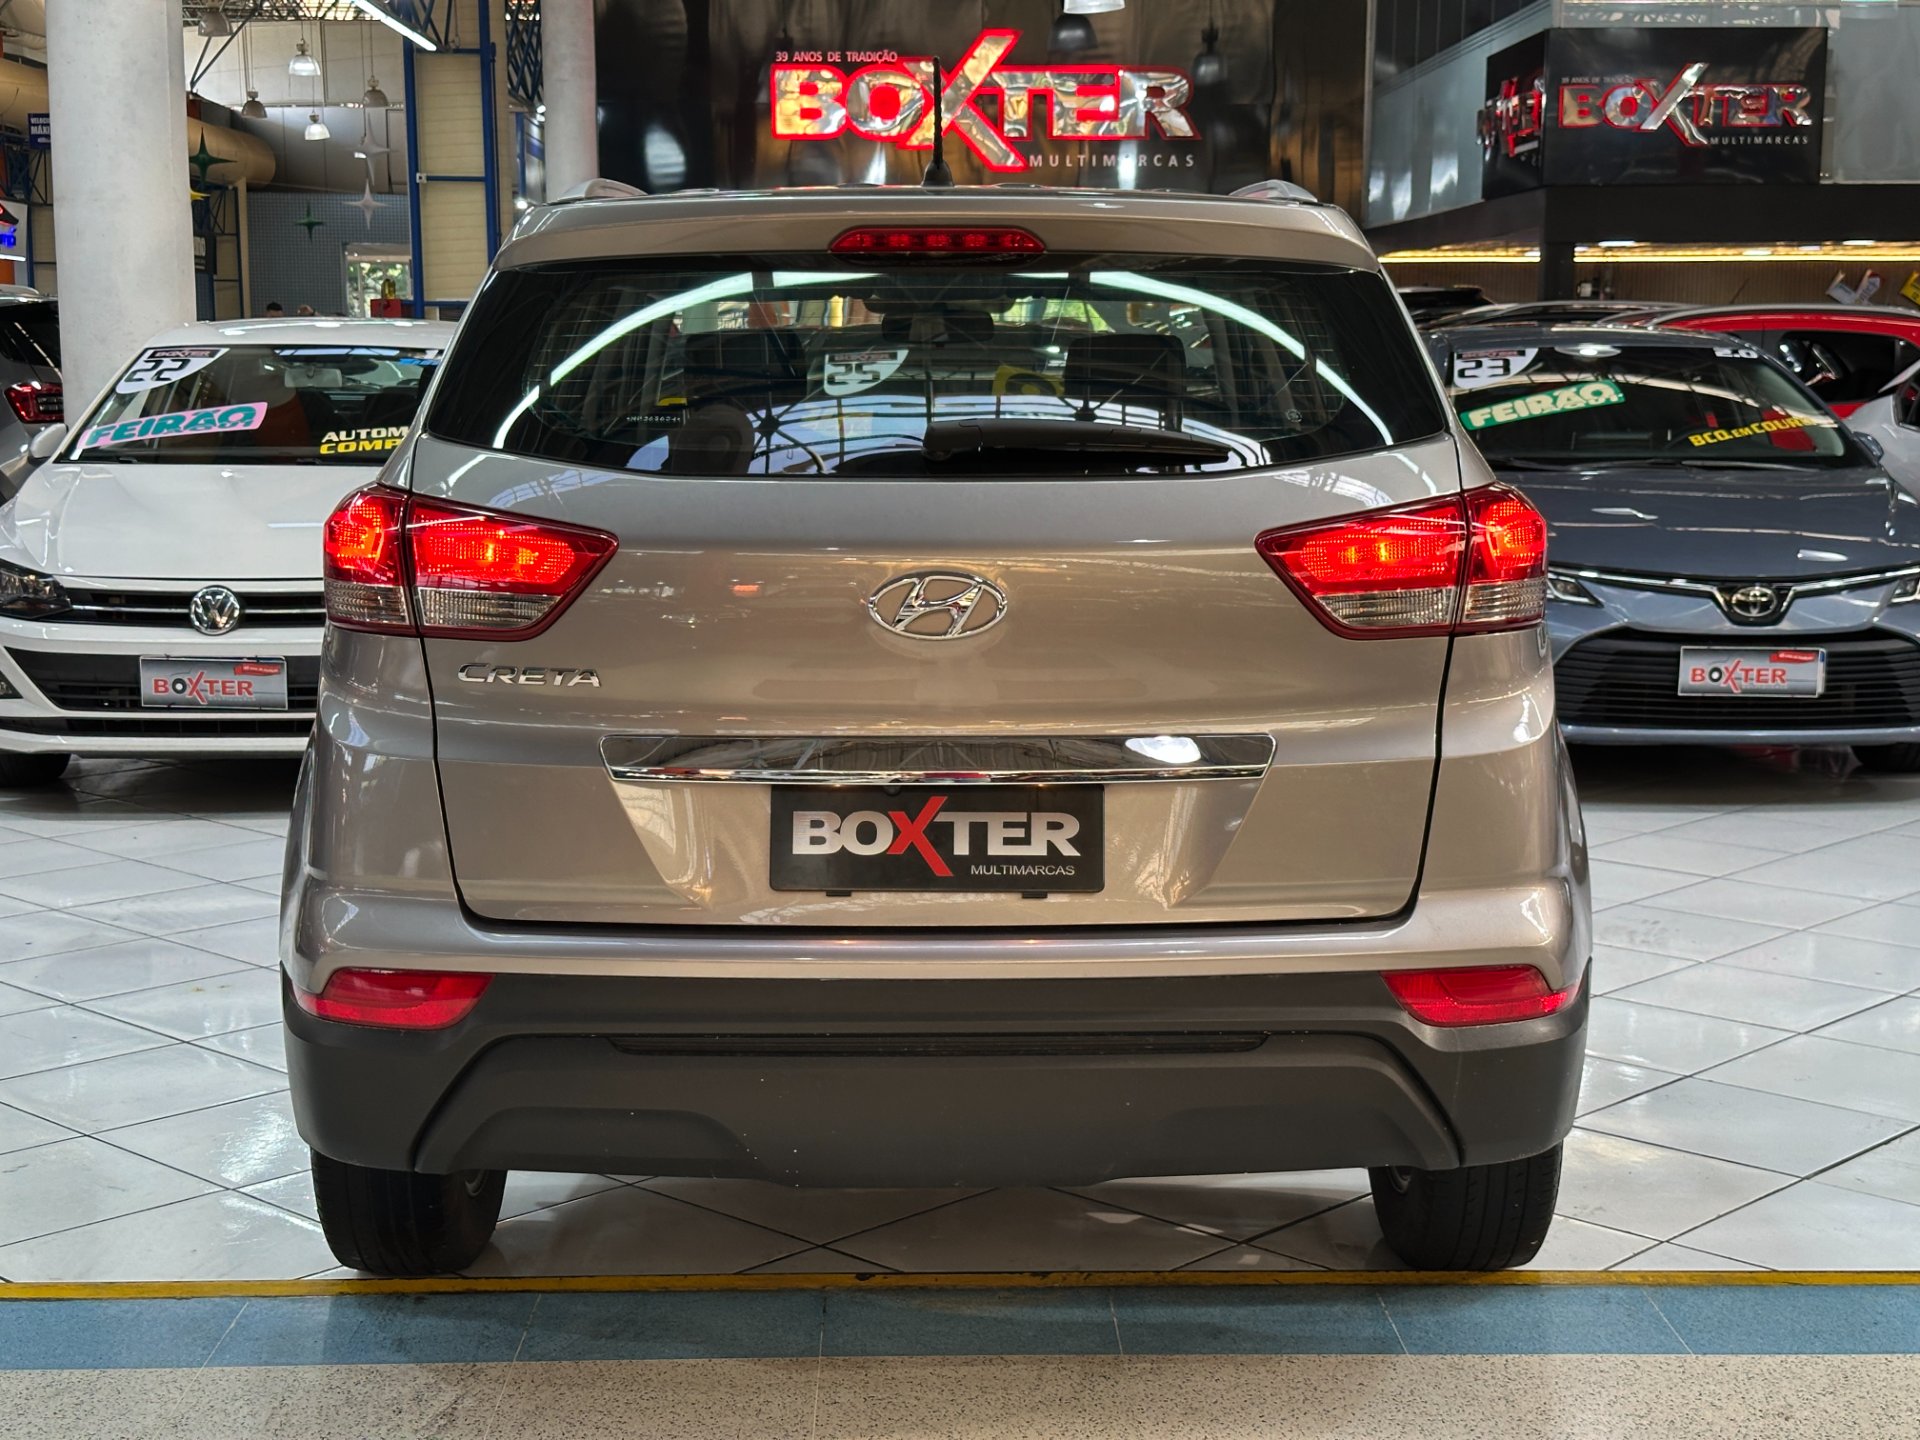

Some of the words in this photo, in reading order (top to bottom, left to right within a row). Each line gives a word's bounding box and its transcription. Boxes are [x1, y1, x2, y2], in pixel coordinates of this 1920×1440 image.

[775, 51, 788, 62] 39
[793, 51, 822, 62] ANOS
[827, 51, 841, 62] DE
[846, 49, 898, 64] TRADIÇÃO
[770, 28, 1201, 172] BOXTER
[1557, 62, 1813, 147] BOXTER
[1710, 136, 1809, 145] MULTIMARCAS
[1029, 154, 1195, 168] MULTIMRCAS
[124, 358, 191, 382] 22
[1457, 358, 1511, 378] 23
[1468, 382, 1619, 427] FEIRÃO
[85, 405, 257, 446] FEIRÃO
[321, 426, 410, 443] AUTOM
[320, 438, 402, 454] COMP
[457, 663, 601, 687] CRETA
[1690, 659, 1787, 693] BOXTER
[152, 671, 254, 704] BOXTER
[792, 796, 1081, 877] BOXTER
[970, 864, 1075, 876] MULTIMARCAS
